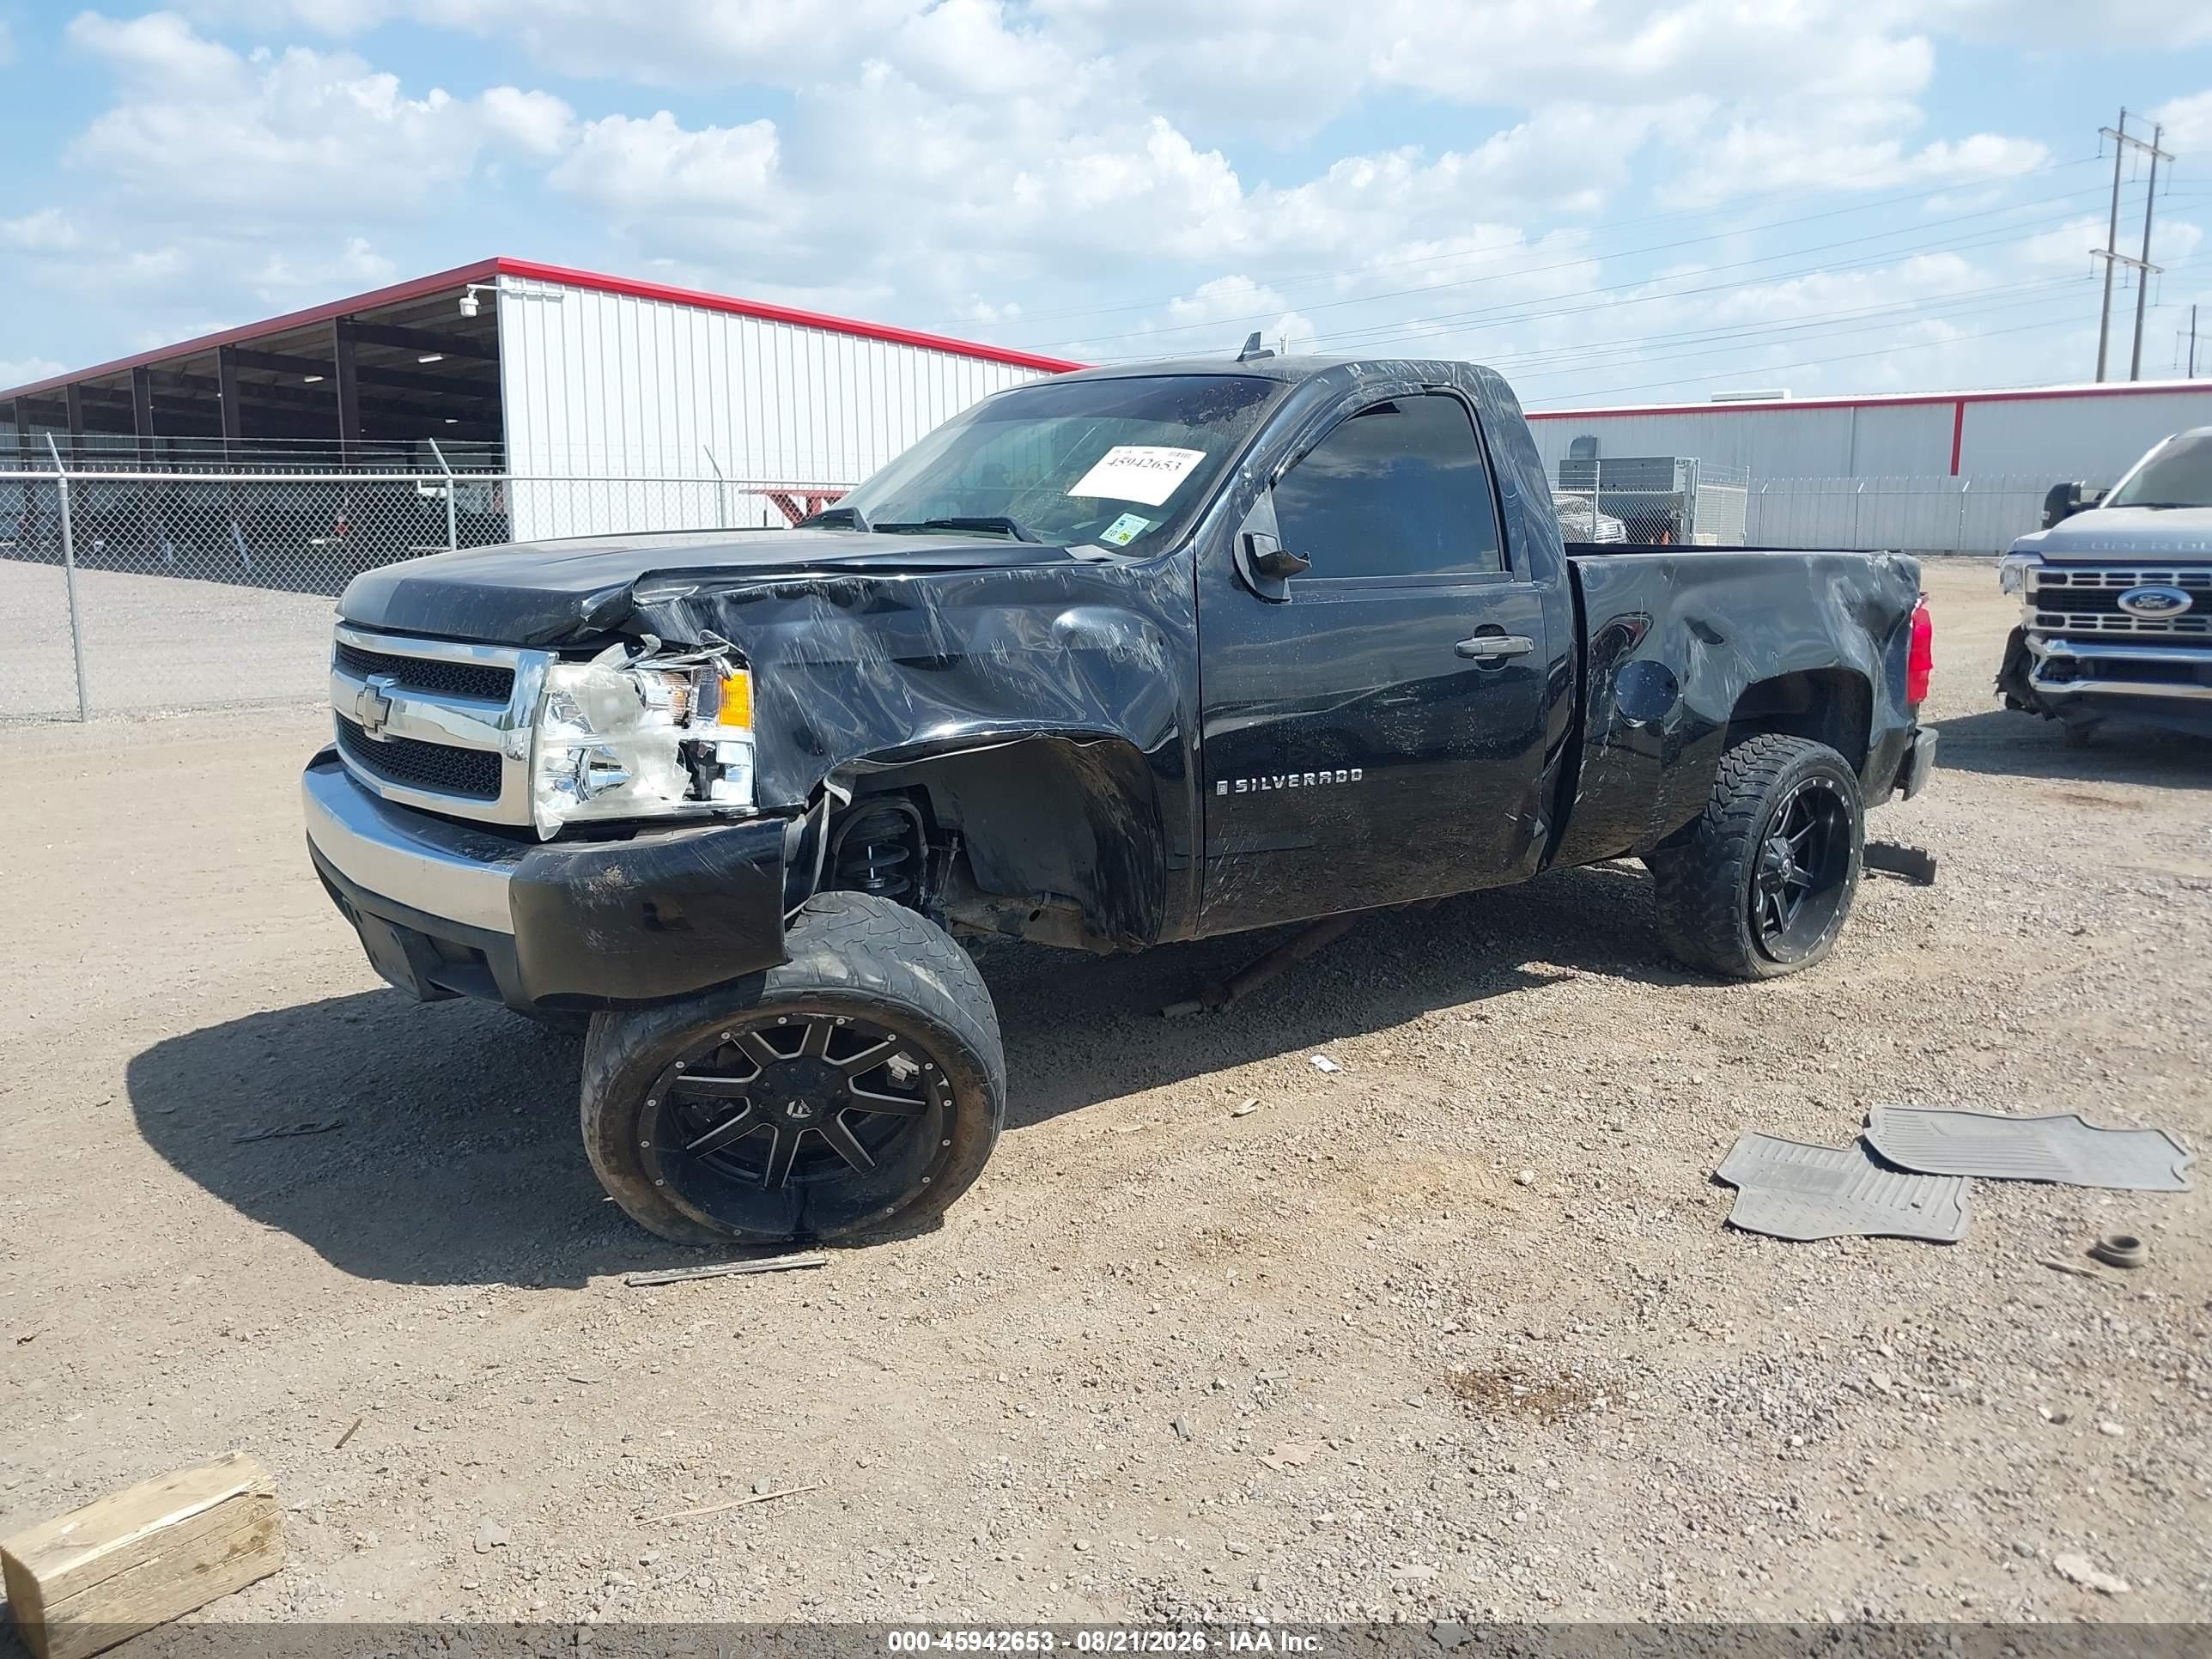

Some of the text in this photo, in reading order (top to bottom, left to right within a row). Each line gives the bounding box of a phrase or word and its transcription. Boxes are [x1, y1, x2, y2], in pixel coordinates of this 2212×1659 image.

[1106, 456, 1182, 472] 45942653
[1118, 532, 1132, 541] 26
[2135, 594, 2172, 608] Ford
[1234, 768, 1364, 793] SILVERADO
